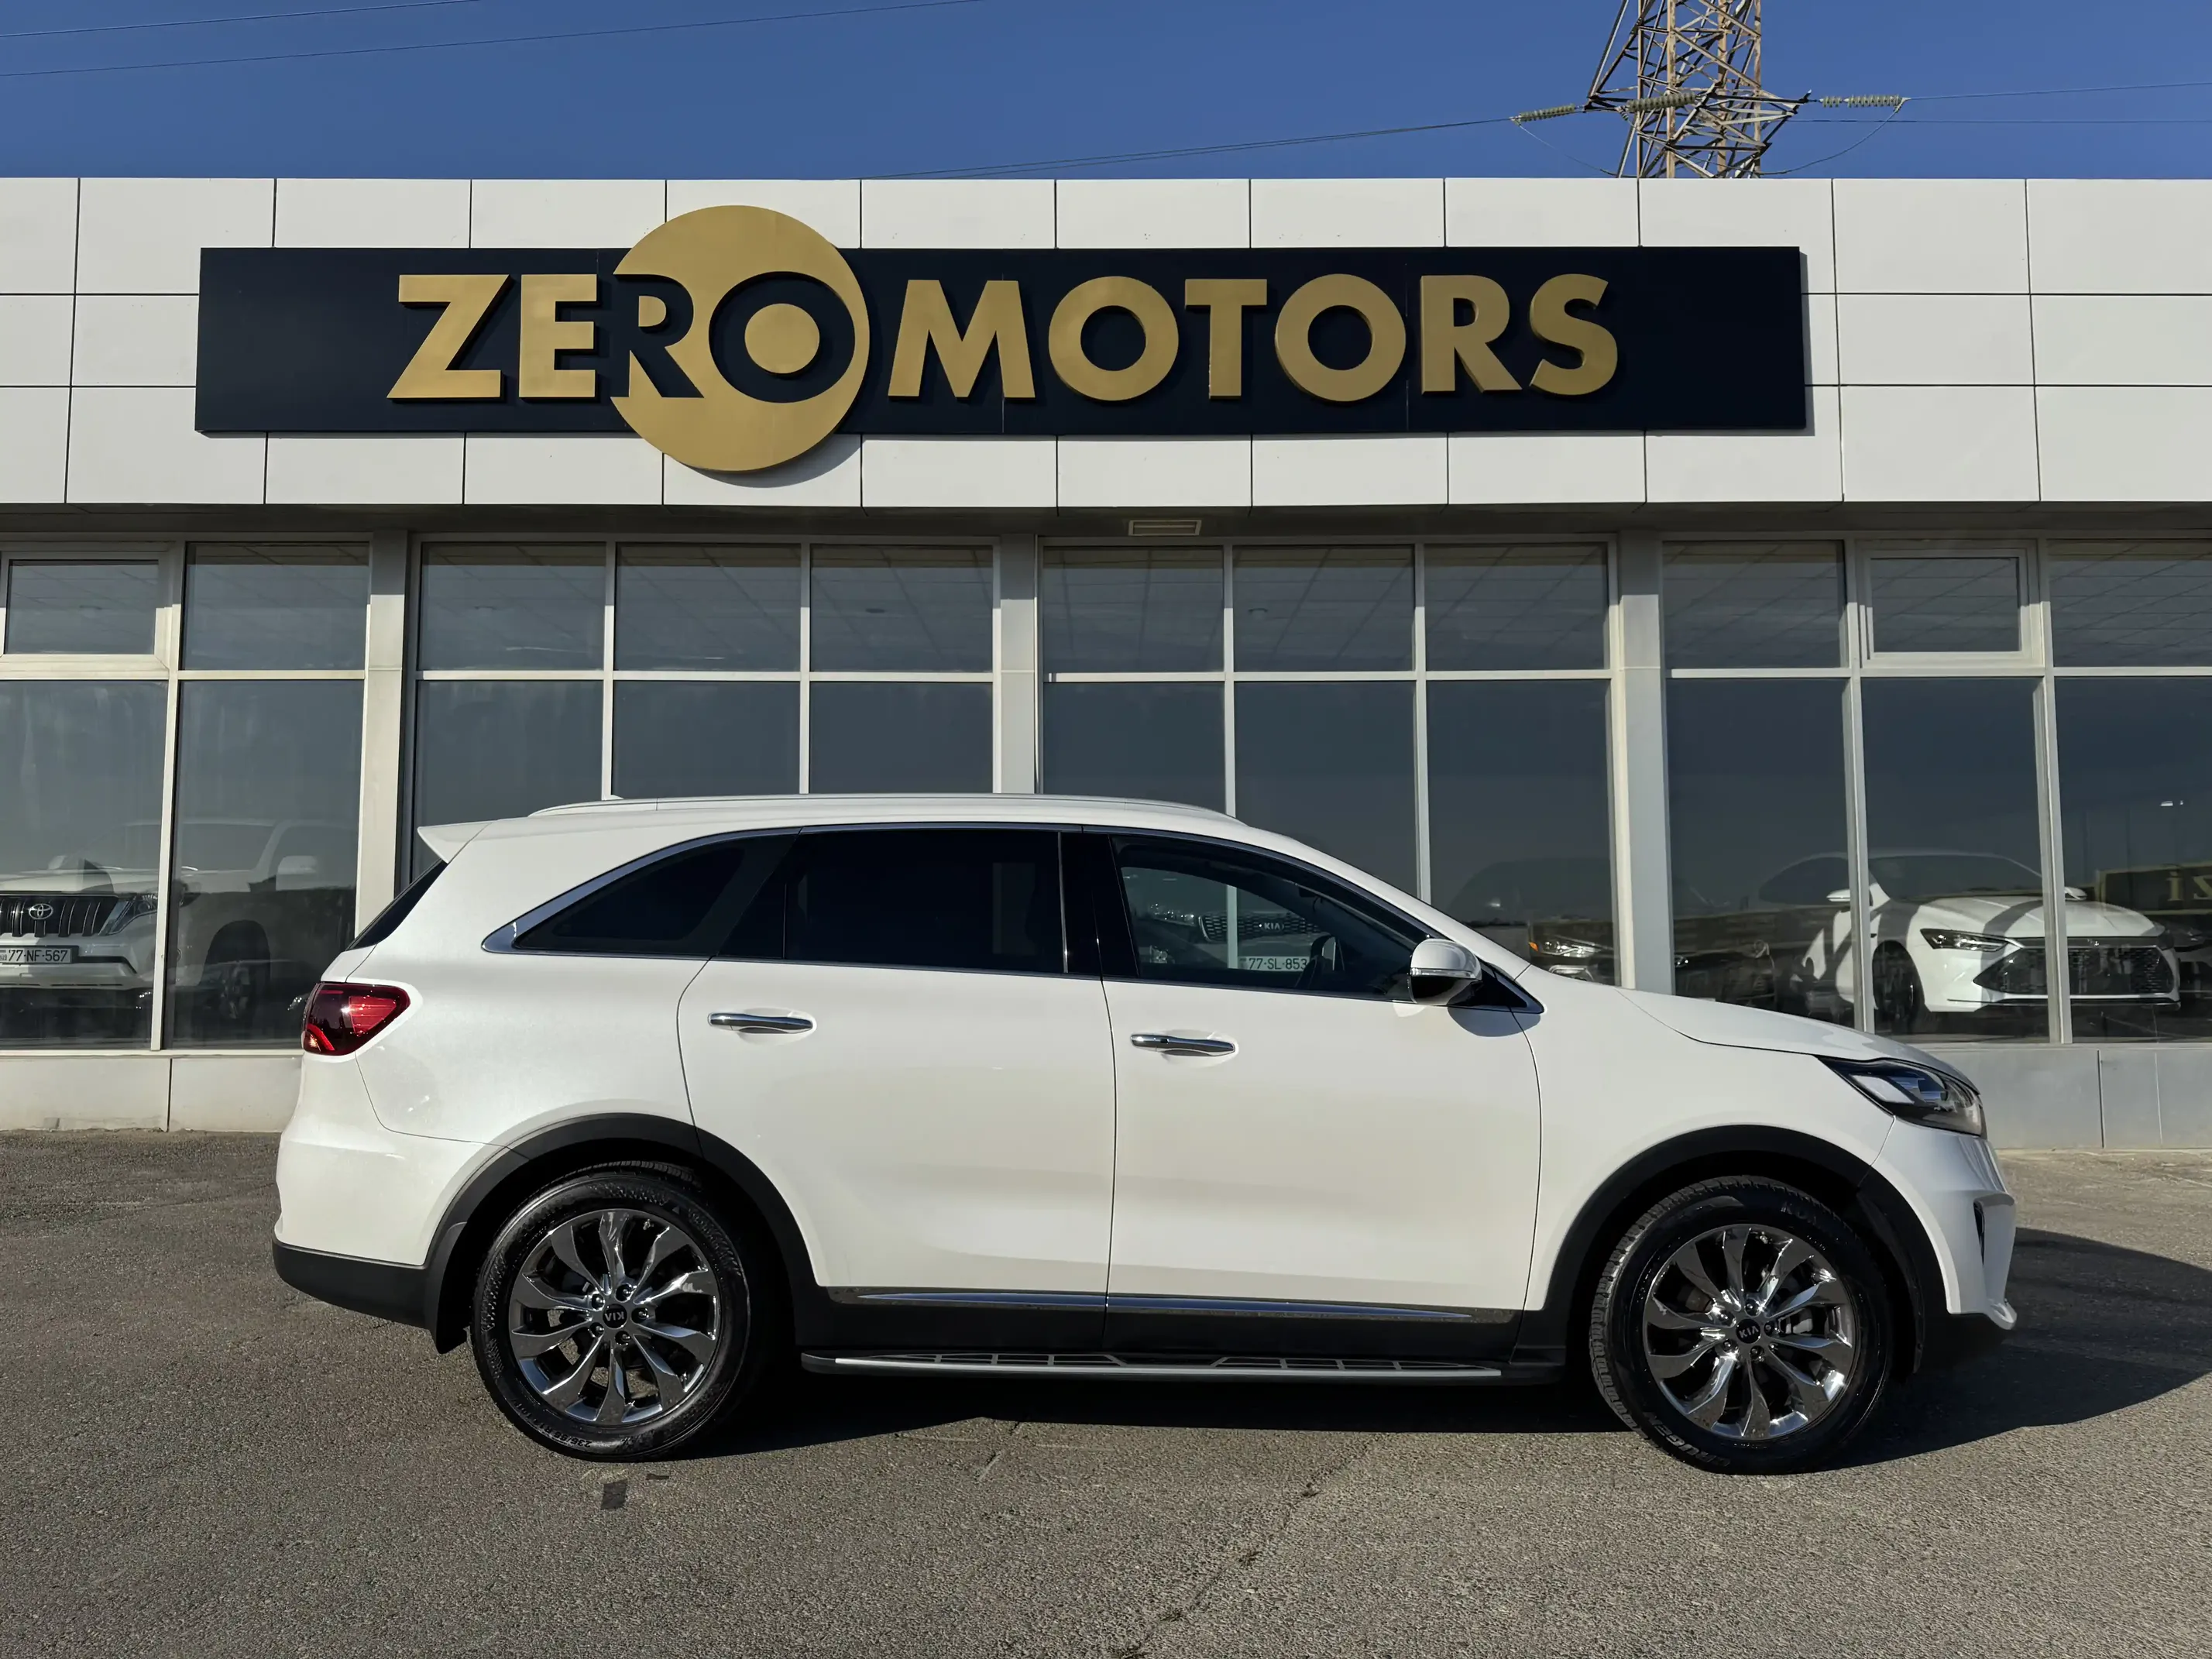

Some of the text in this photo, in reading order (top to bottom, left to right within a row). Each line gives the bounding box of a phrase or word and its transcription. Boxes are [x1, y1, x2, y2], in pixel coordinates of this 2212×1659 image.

[386, 270, 1619, 404] ZERO MOTORS
[1263, 922, 1281, 930] KIA
[604, 1310, 625, 1321] KIA
[1738, 1325, 1760, 1339] KIA
